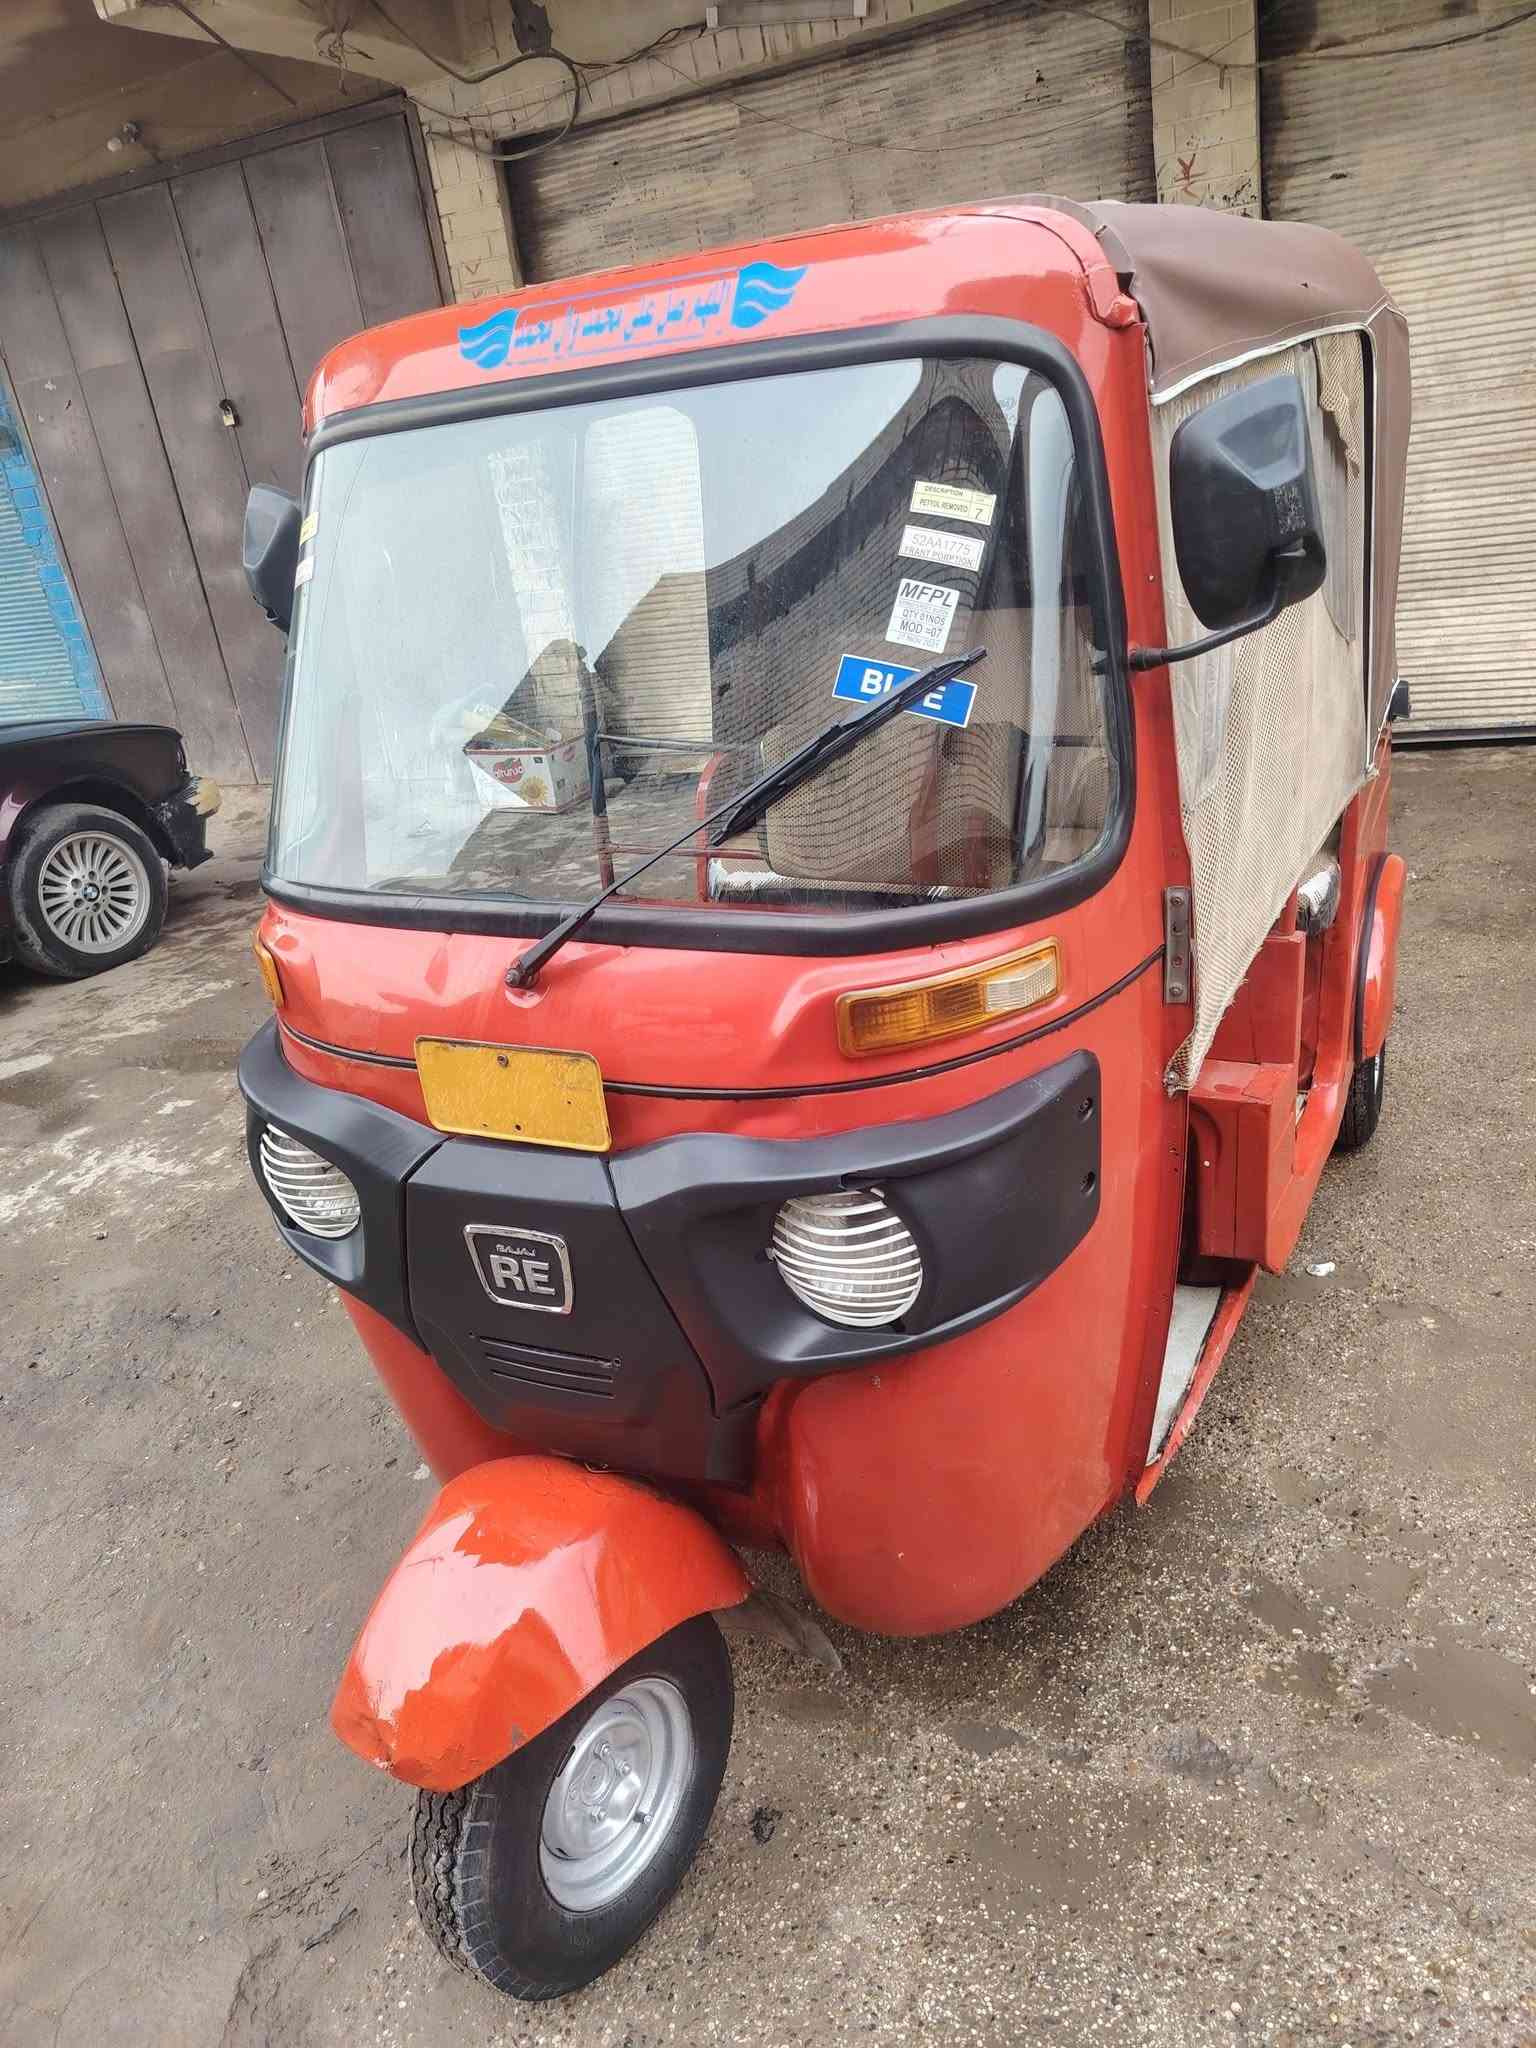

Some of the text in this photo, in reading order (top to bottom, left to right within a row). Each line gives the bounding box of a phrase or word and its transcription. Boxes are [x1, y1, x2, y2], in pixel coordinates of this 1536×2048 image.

[513, 318, 552, 349] محمد
[581, 305, 624, 337] محمد
[975, 507, 984, 519] 7
[900, 582, 953, 607] MFPL
[900, 620, 923, 634] MOD
[489, 1254, 556, 1296] RE
